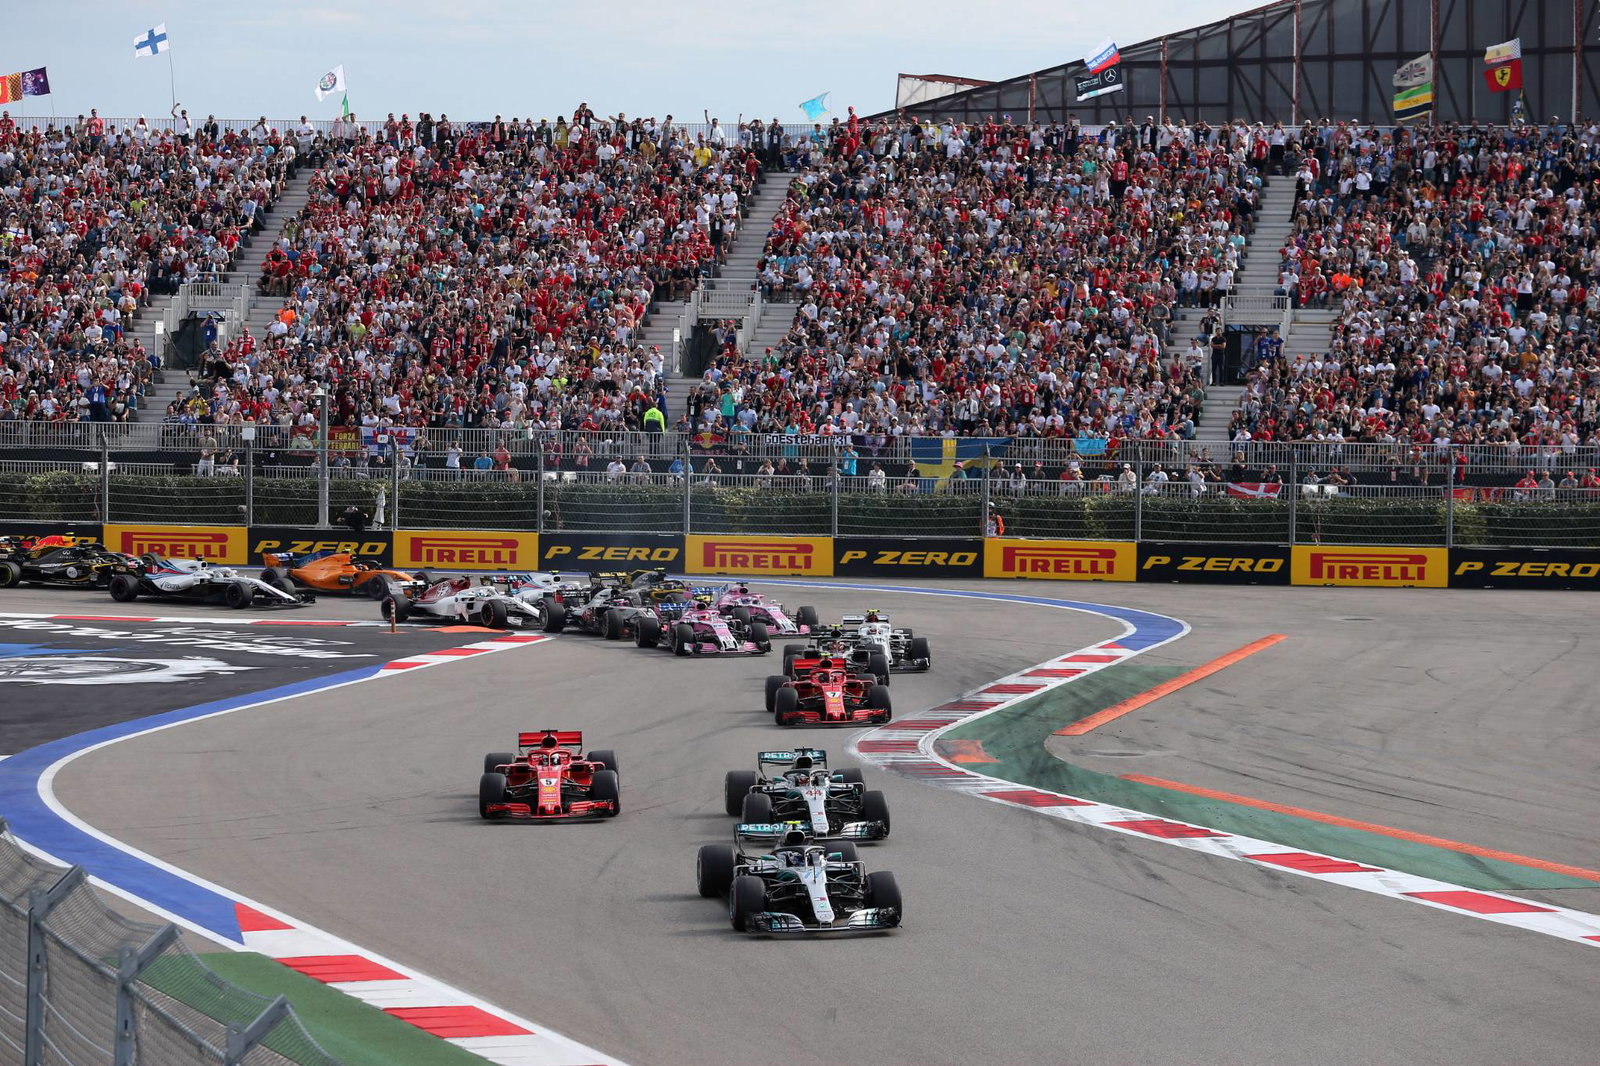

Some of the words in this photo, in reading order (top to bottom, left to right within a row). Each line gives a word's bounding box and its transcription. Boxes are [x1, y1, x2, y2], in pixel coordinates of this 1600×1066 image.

[335, 432, 356, 440] FORZA
[121, 531, 229, 558] PIRELLI
[254, 540, 281, 553] P
[287, 541, 388, 556] ZERO
[410, 537, 519, 564] PIRELLI
[545, 546, 571, 559] P
[577, 546, 679, 561] ZERO
[703, 542, 814, 569] PIRELLI
[840, 550, 868, 564] P
[873, 551, 978, 566] ZERO
[1002, 546, 1117, 574] PIRELLI
[1142, 556, 1171, 569] P
[1177, 556, 1285, 572] ZERO
[1310, 553, 1428, 580] PIRELLI
[1454, 561, 1484, 576] P
[1490, 562, 1600, 577] ZERO
[806, 789, 824, 797] 44
